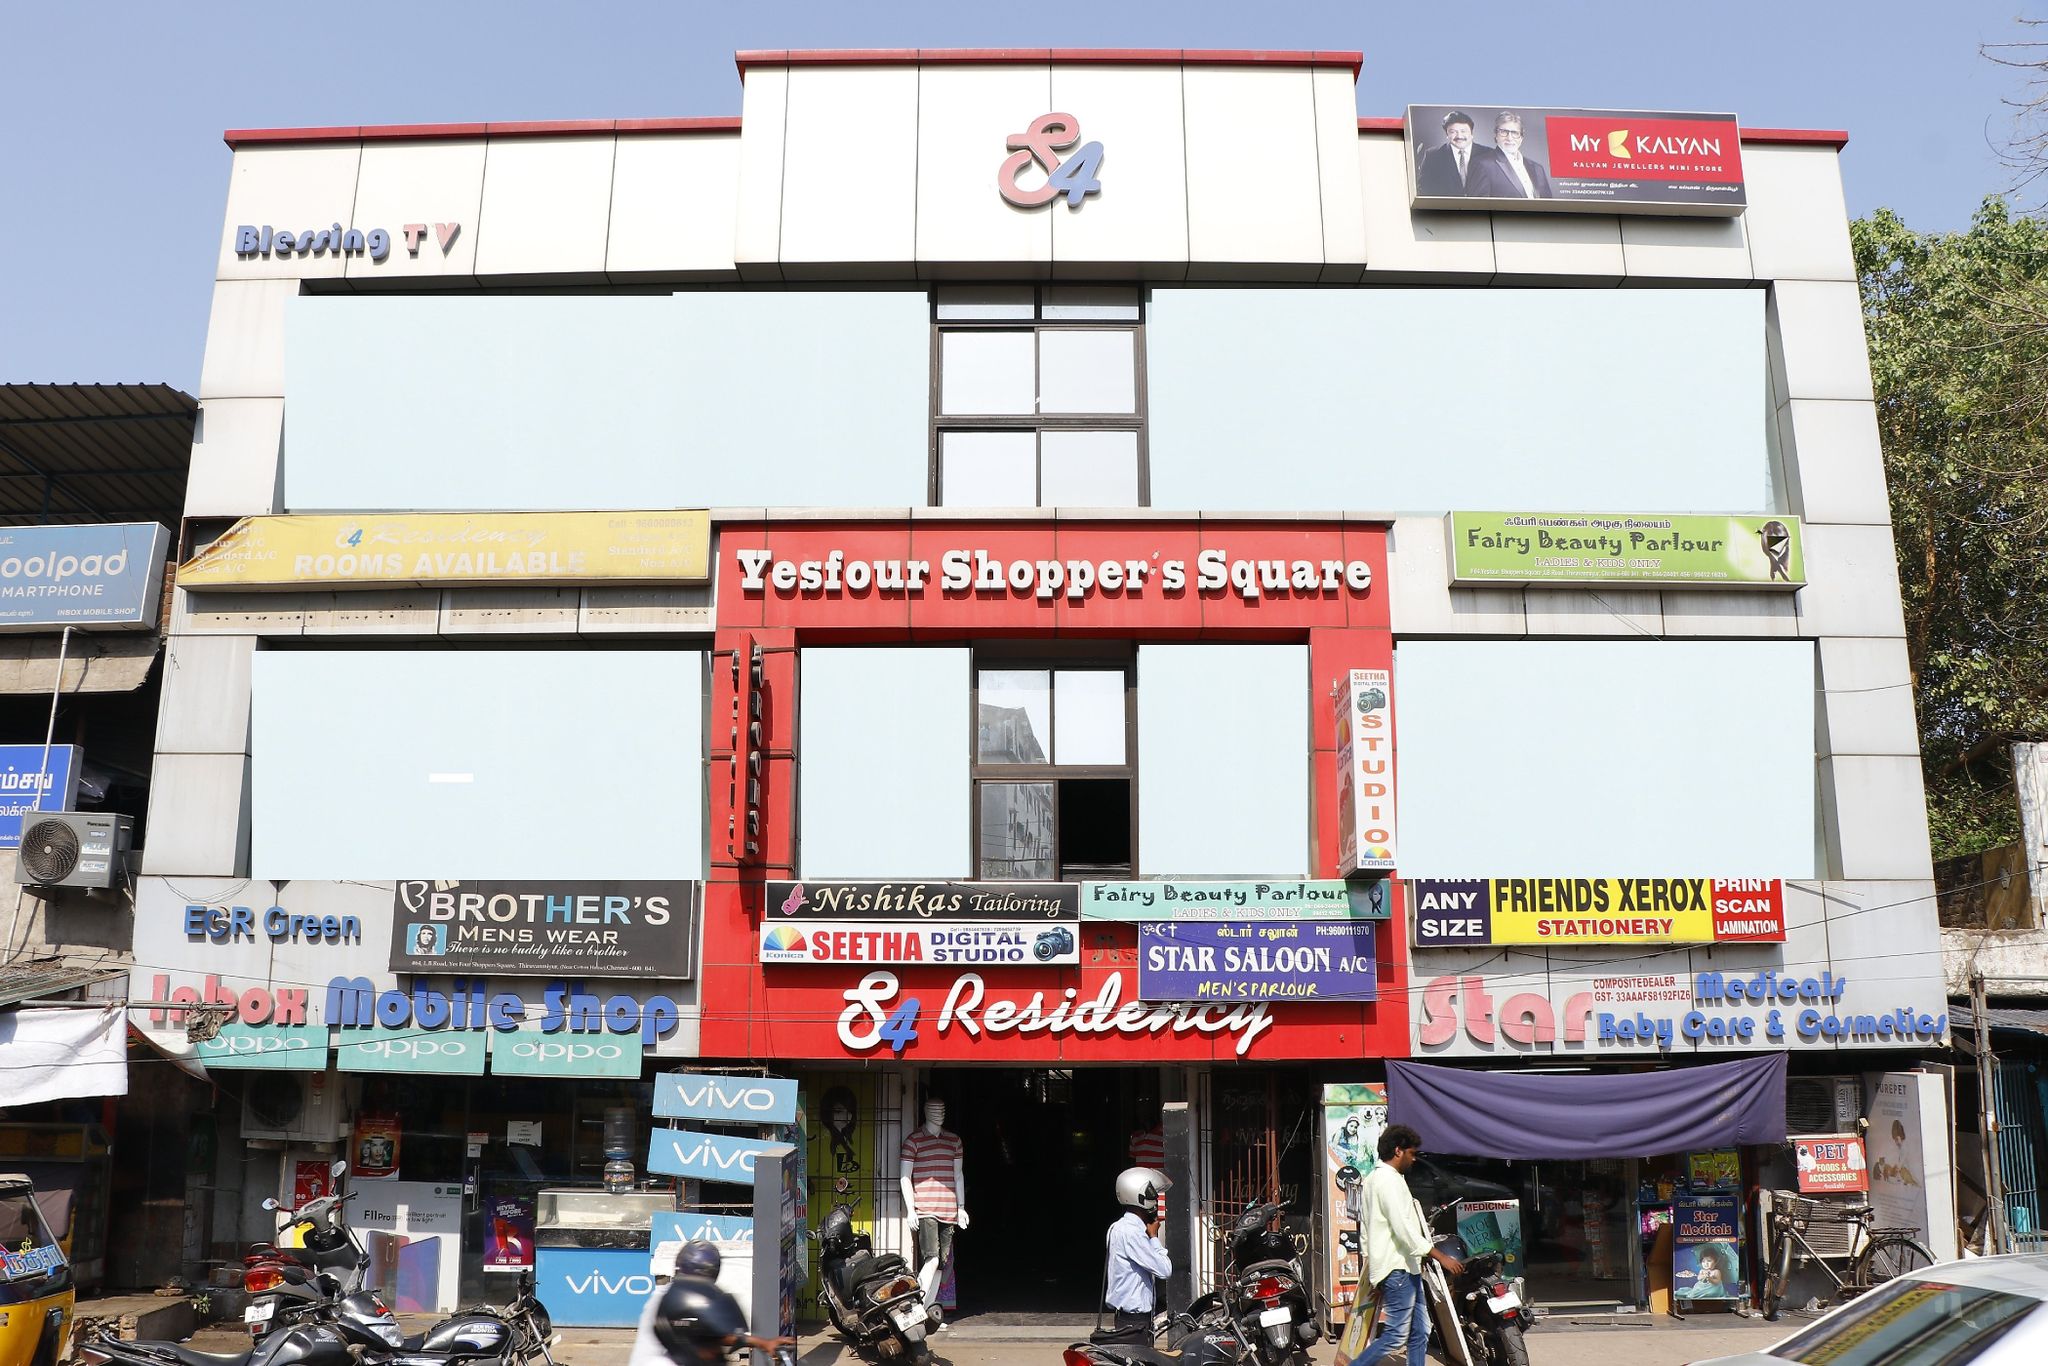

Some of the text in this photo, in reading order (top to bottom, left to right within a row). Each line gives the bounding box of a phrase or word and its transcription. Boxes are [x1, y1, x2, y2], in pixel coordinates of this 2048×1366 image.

[1636, 135, 1721, 157] KALYAN
[1573, 161, 1608, 169] KALYAN
[1612, 162, 1665, 170] JEWELLERS
[235, 222, 391, 260] Blessing
[1468, 527, 1723, 555] Fairy Beauty Parlour
[0, 549, 128, 582] oolpad
[294, 551, 588, 577] ROOMS AVAILABLE
[1535, 556, 1661, 568] LADIES & KIDS ONLY
[736, 548, 1372, 599] Yesfour Shopper's Square
[1, 584, 105, 598] MARTPHONE
[83, 608, 113, 616] MOBILE
[114, 607, 136, 615] SHOP
[1354, 672, 1386, 680] SEETHA
[1361, 714, 1389, 843] STUDIO
[1361, 858, 1395, 868] Konica
[1714, 879, 1774, 892] PRINT
[811, 885, 1061, 917] Nishikas Tailoring
[1093, 884, 1348, 906] Fairy Beauty Parlour
[1420, 892, 1475, 910] ANY
[1495, 879, 1706, 913] FRIENDS XEROX
[429, 892, 671, 925] BROTHER'S
[1174, 907, 1301, 918] LADIES & KIDS ONLY
[1715, 898, 1770, 913] SCAN
[263, 906, 361, 939] Green
[1217, 923, 1299, 940] ஸ்டார் சலூன்
[1315, 925, 1370, 937] PH:9600111970
[1421, 918, 1483, 937] SIZE
[1537, 918, 1674, 936] STATIONERY
[1716, 917, 1778, 935] LAMINATION
[458, 925, 619, 944] MENS WEAR
[930, 931, 1027, 946] DIGITAL
[446, 941, 480, 954] There
[481, 943, 491, 953] is
[493, 946, 508, 955] no
[511, 943, 548, 959] buddy
[551, 943, 573, 956] like
[586, 944, 629, 957] brother
[812, 931, 924, 961] SEETHA
[932, 948, 1025, 962] STUDIO
[765, 951, 804, 960] Konica
[1148, 946, 1368, 974] STAR SALOON A/C
[1251, 982, 1319, 997] PARLOUR
[1695, 967, 1846, 998] Medicals
[149, 974, 680, 1044] Inbox Mobile Shop
[937, 971, 1274, 1055] Residency
[1420, 975, 1593, 1046] Star
[1598, 1006, 1946, 1047] Baby Care & Cosmetics
[357, 1035, 467, 1059] oppo
[511, 1039, 622, 1062] oppo
[677, 1080, 776, 1111] vivo
[1814, 1144, 1846, 1160] PET
[1817, 1163, 1848, 1173] FOODS &
[1808, 1172, 1858, 1183] ACCESSORIES
[1464, 1202, 1511, 1212] MEDICINE
[1693, 1210, 1719, 1222] Star
[1680, 1223, 1732, 1236] Medicals
[565, 1269, 653, 1295] vivo
